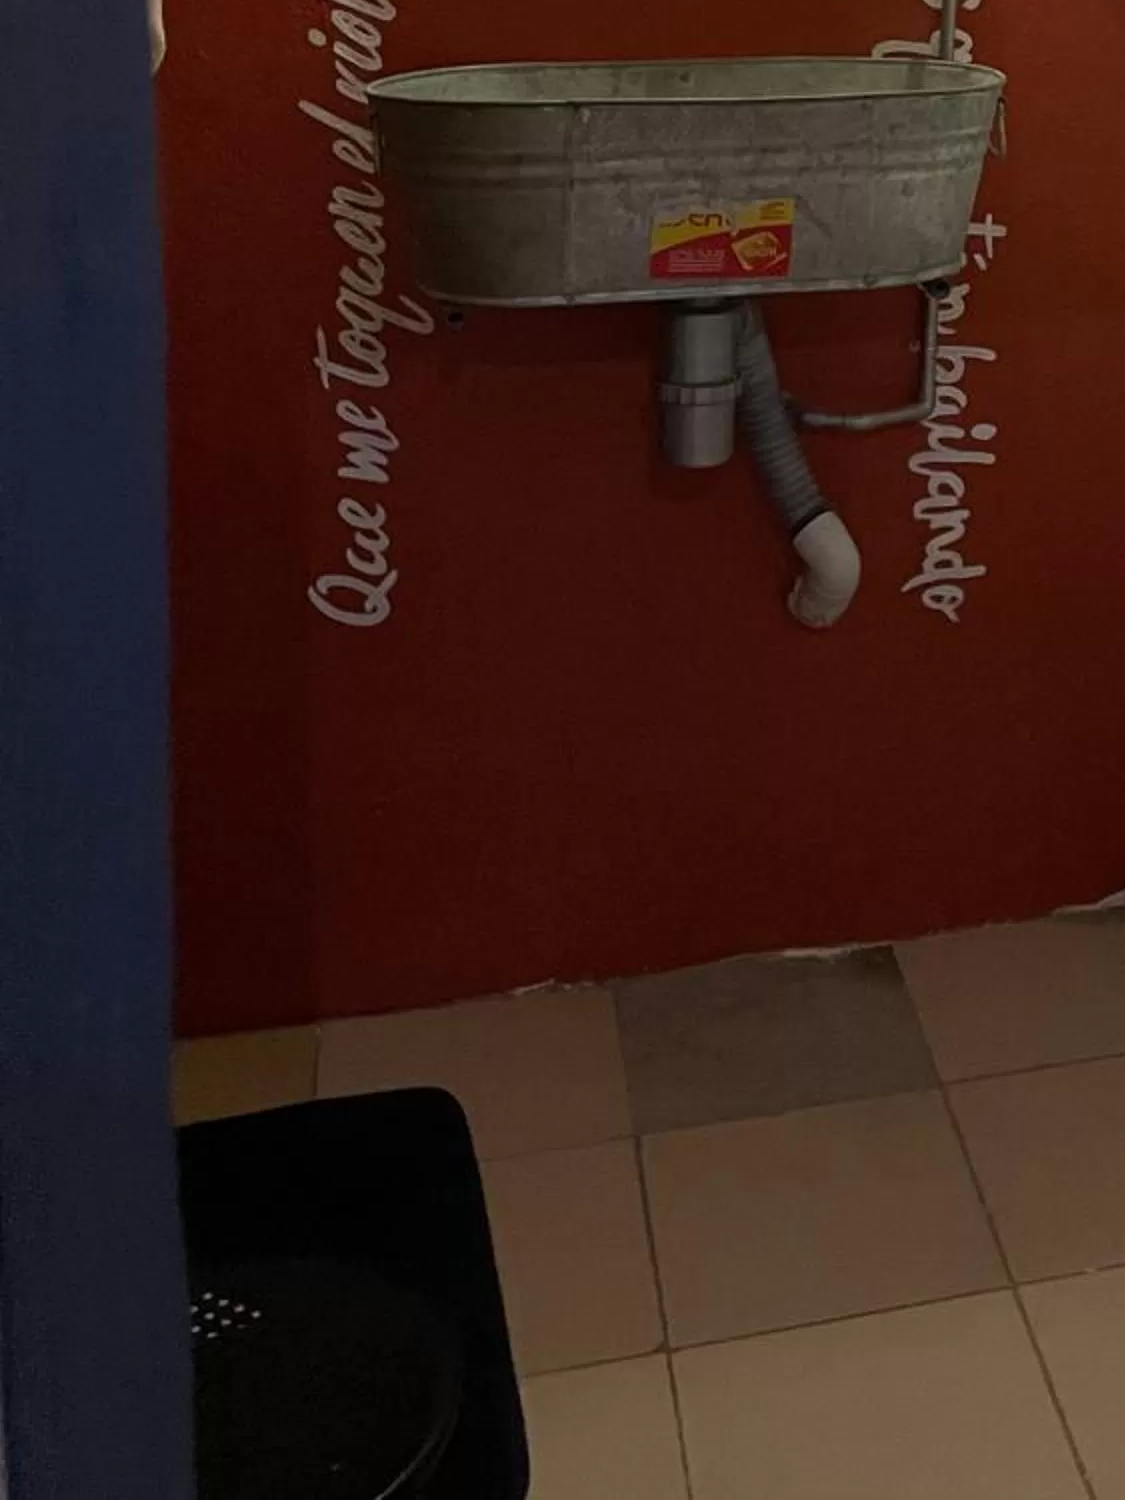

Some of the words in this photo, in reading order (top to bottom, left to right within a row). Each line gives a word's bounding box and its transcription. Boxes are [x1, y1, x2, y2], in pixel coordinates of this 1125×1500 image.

[298, 98, 378, 176] el
[310, 178, 436, 390] toquen
[334, 398, 400, 484] me
[901, 346, 998, 623] bailando
[306, 496, 400, 628] Que
